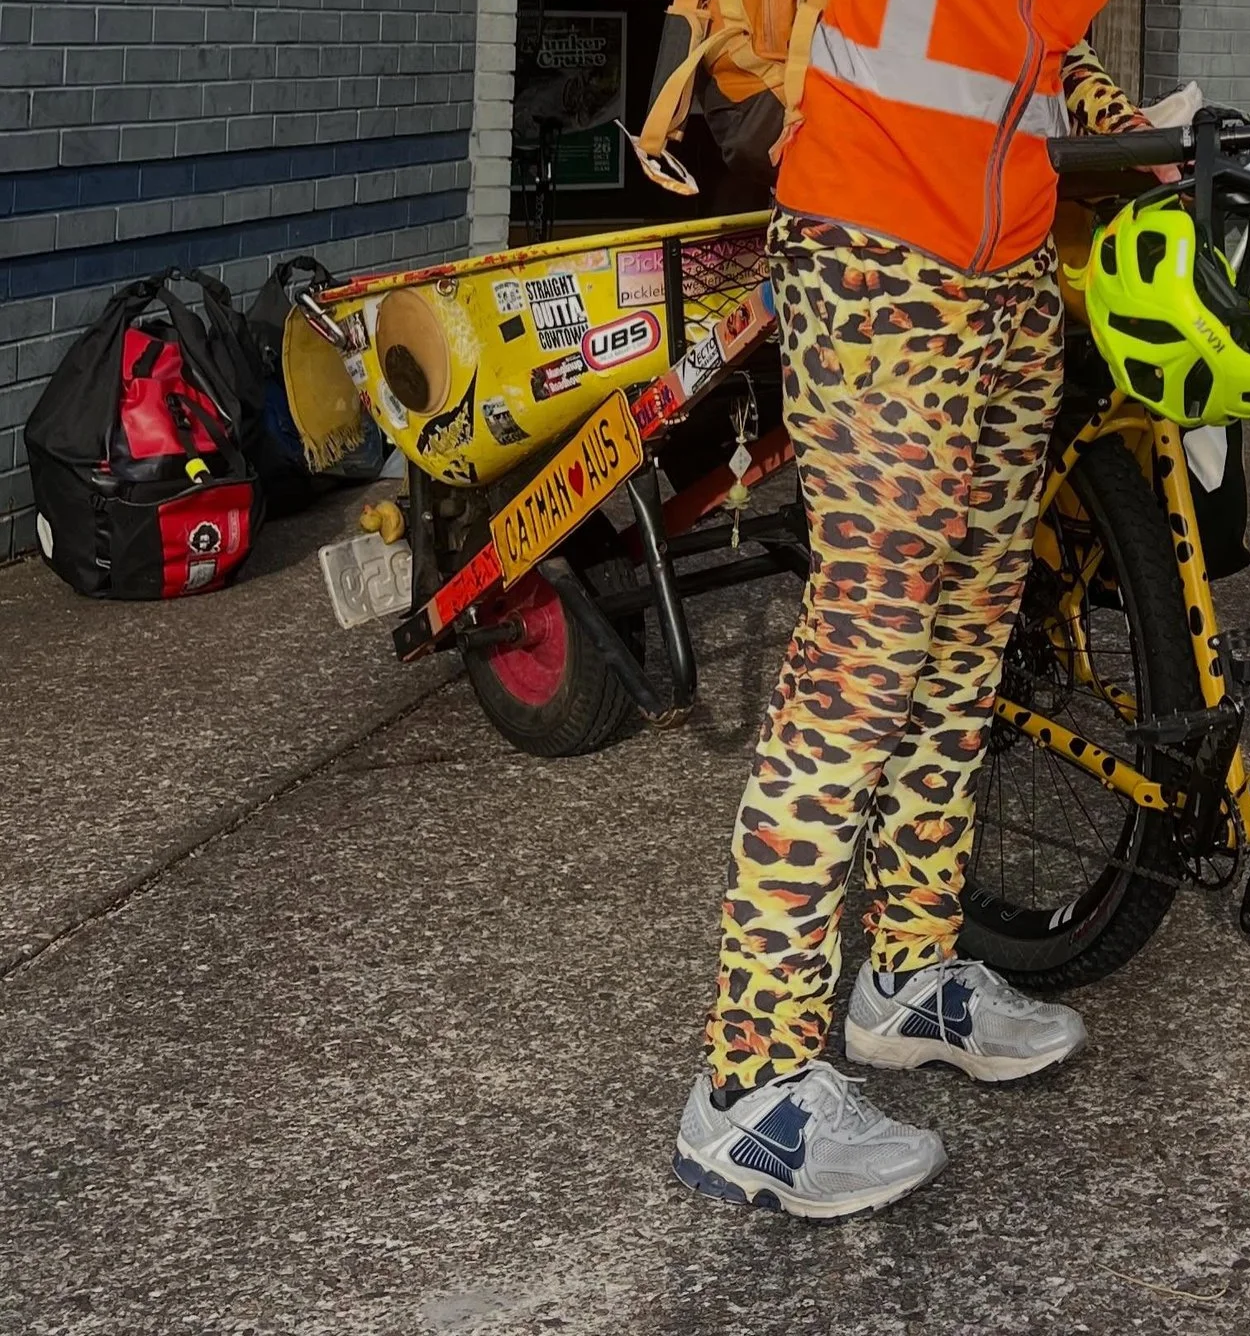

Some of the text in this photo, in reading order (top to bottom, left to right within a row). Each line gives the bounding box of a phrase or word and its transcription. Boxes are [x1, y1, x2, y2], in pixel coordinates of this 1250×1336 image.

[537, 49, 607, 68] Cruise
[525, 274, 576, 301] STRAIGHT
[531, 297, 585, 330] OUTTA
[591, 320, 648, 357] UBS
[505, 419, 619, 562] CATMAN AUS
